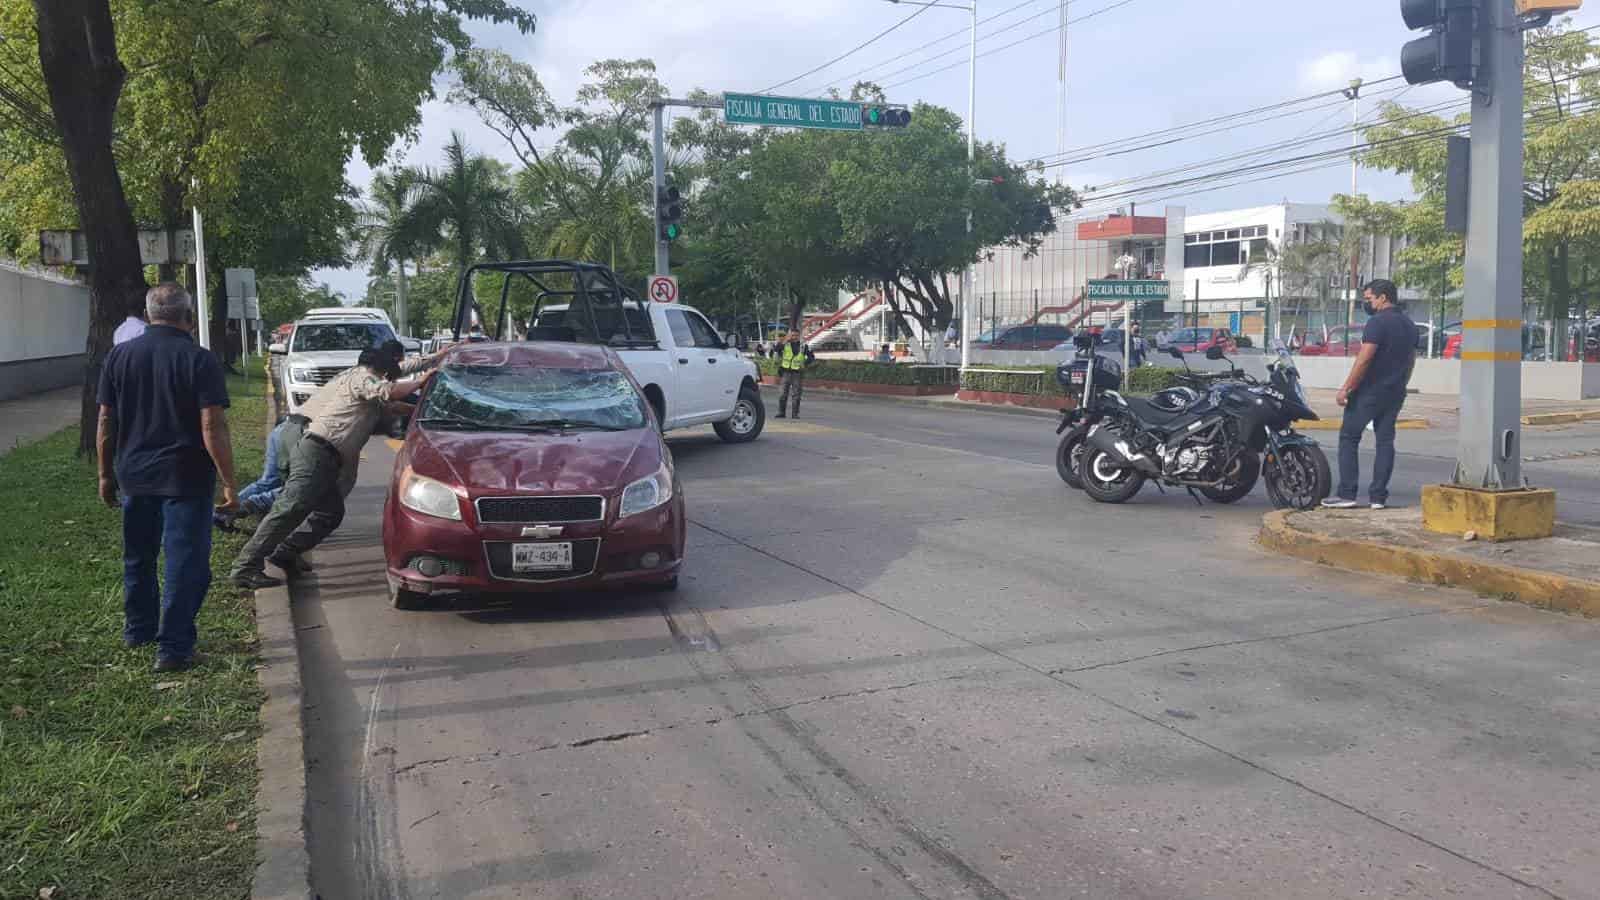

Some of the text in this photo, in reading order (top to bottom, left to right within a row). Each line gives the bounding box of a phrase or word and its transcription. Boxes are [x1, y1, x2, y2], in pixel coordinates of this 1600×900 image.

[726, 99, 860, 124] FISCALIA GENERAL DEL ESTADO
[1088, 284, 1114, 296] FISCALIA
[1132, 284, 1145, 296] DEL
[1145, 284, 1169, 296] ESTADO
